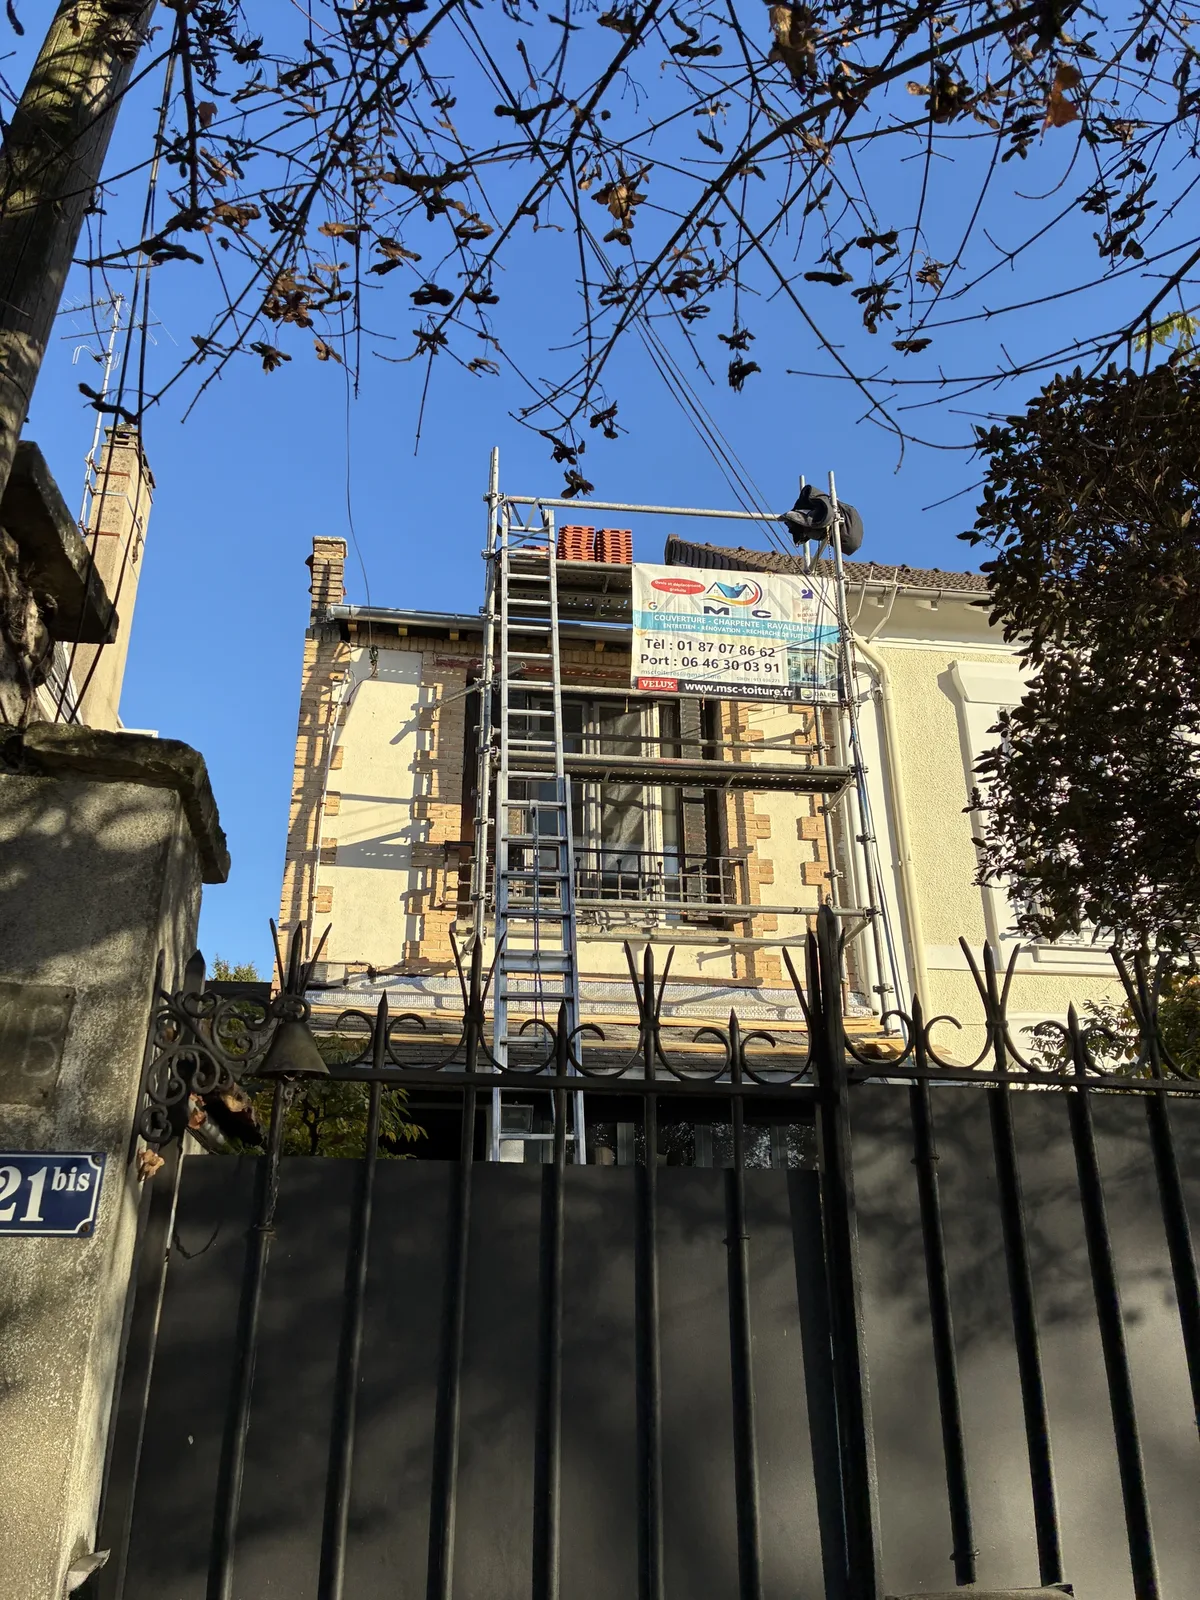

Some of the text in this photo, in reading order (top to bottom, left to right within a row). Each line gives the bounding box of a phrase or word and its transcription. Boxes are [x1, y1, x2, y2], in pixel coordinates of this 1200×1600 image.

[654, 614, 706, 624] COUVERTURE
[713, 618, 760, 628] CHARPENTE
[767, 623, 817, 633] RAVALEMEN
[746, 628, 781, 637] RECHERCHE
[677, 640, 692, 651] 01
[698, 642, 714, 652] 87
[718, 643, 735, 654] 07
[739, 645, 755, 656] 86
[760, 647, 775, 658] 62
[640, 654, 670, 666] Port
[681, 656, 698, 667] 06
[702, 658, 719, 669] 46
[723, 659, 740, 671] 30
[743, 661, 759, 672] 03
[764, 663, 780, 673] 91
[641, 680, 676, 689] VELUX
[684, 682, 793, 697] www.msc-toiture.fr
[0, 1165, 91, 1222] 21 bis
